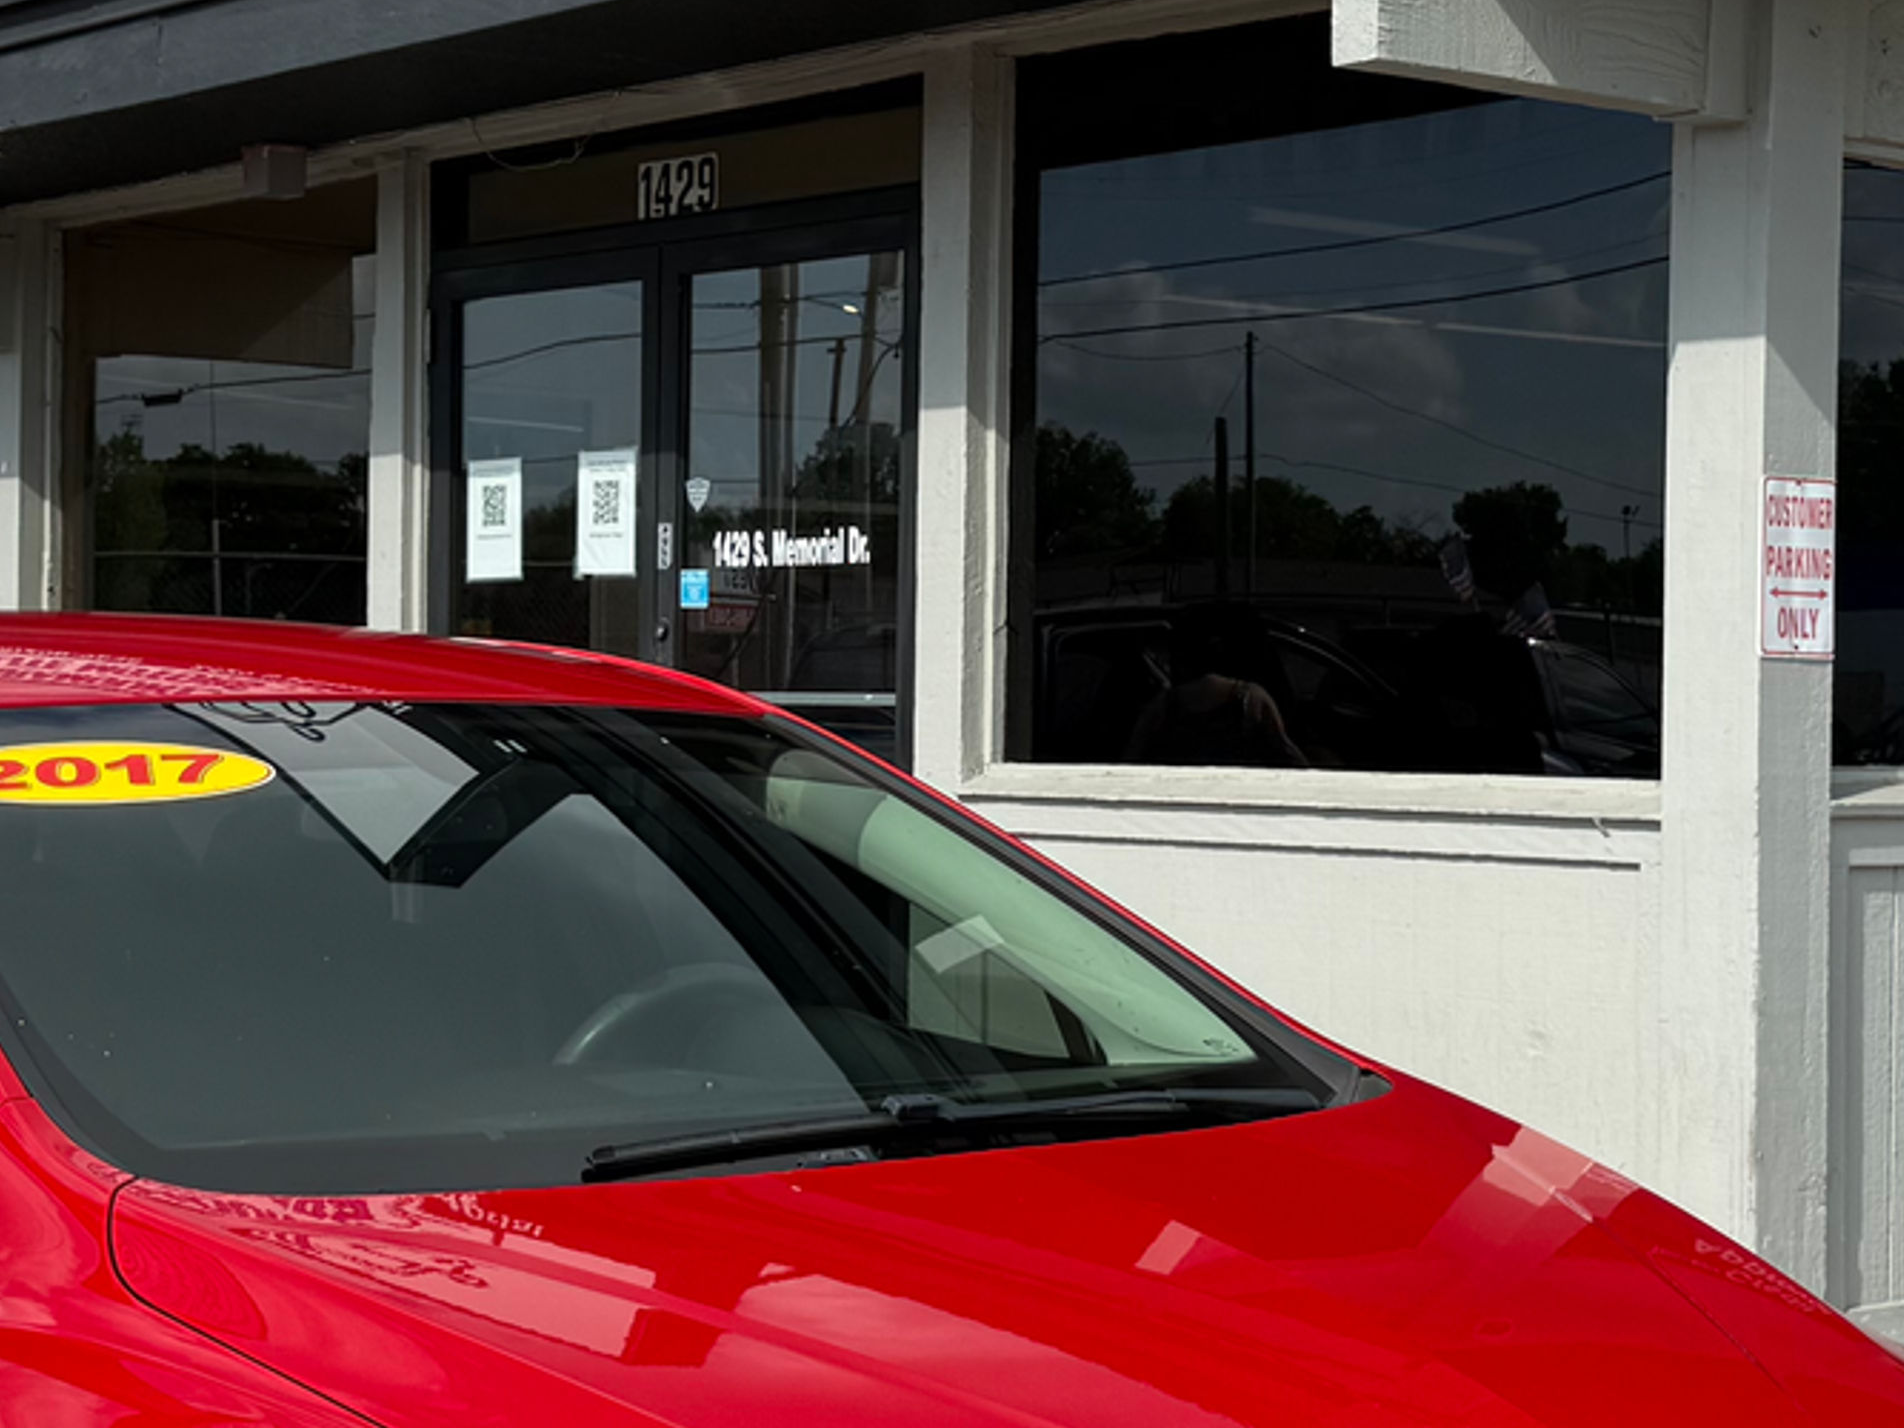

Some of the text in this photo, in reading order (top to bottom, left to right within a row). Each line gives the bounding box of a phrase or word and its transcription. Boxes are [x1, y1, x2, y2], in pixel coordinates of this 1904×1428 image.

[640, 157, 716, 219] 1429
[1768, 495, 1833, 529] CUSTOMER
[713, 530, 751, 567] 1429
[772, 528, 844, 566] Memorial
[848, 525, 871, 564] Dr.
[1767, 545, 1831, 580] PARKING
[1777, 606, 1819, 639] ONLY
